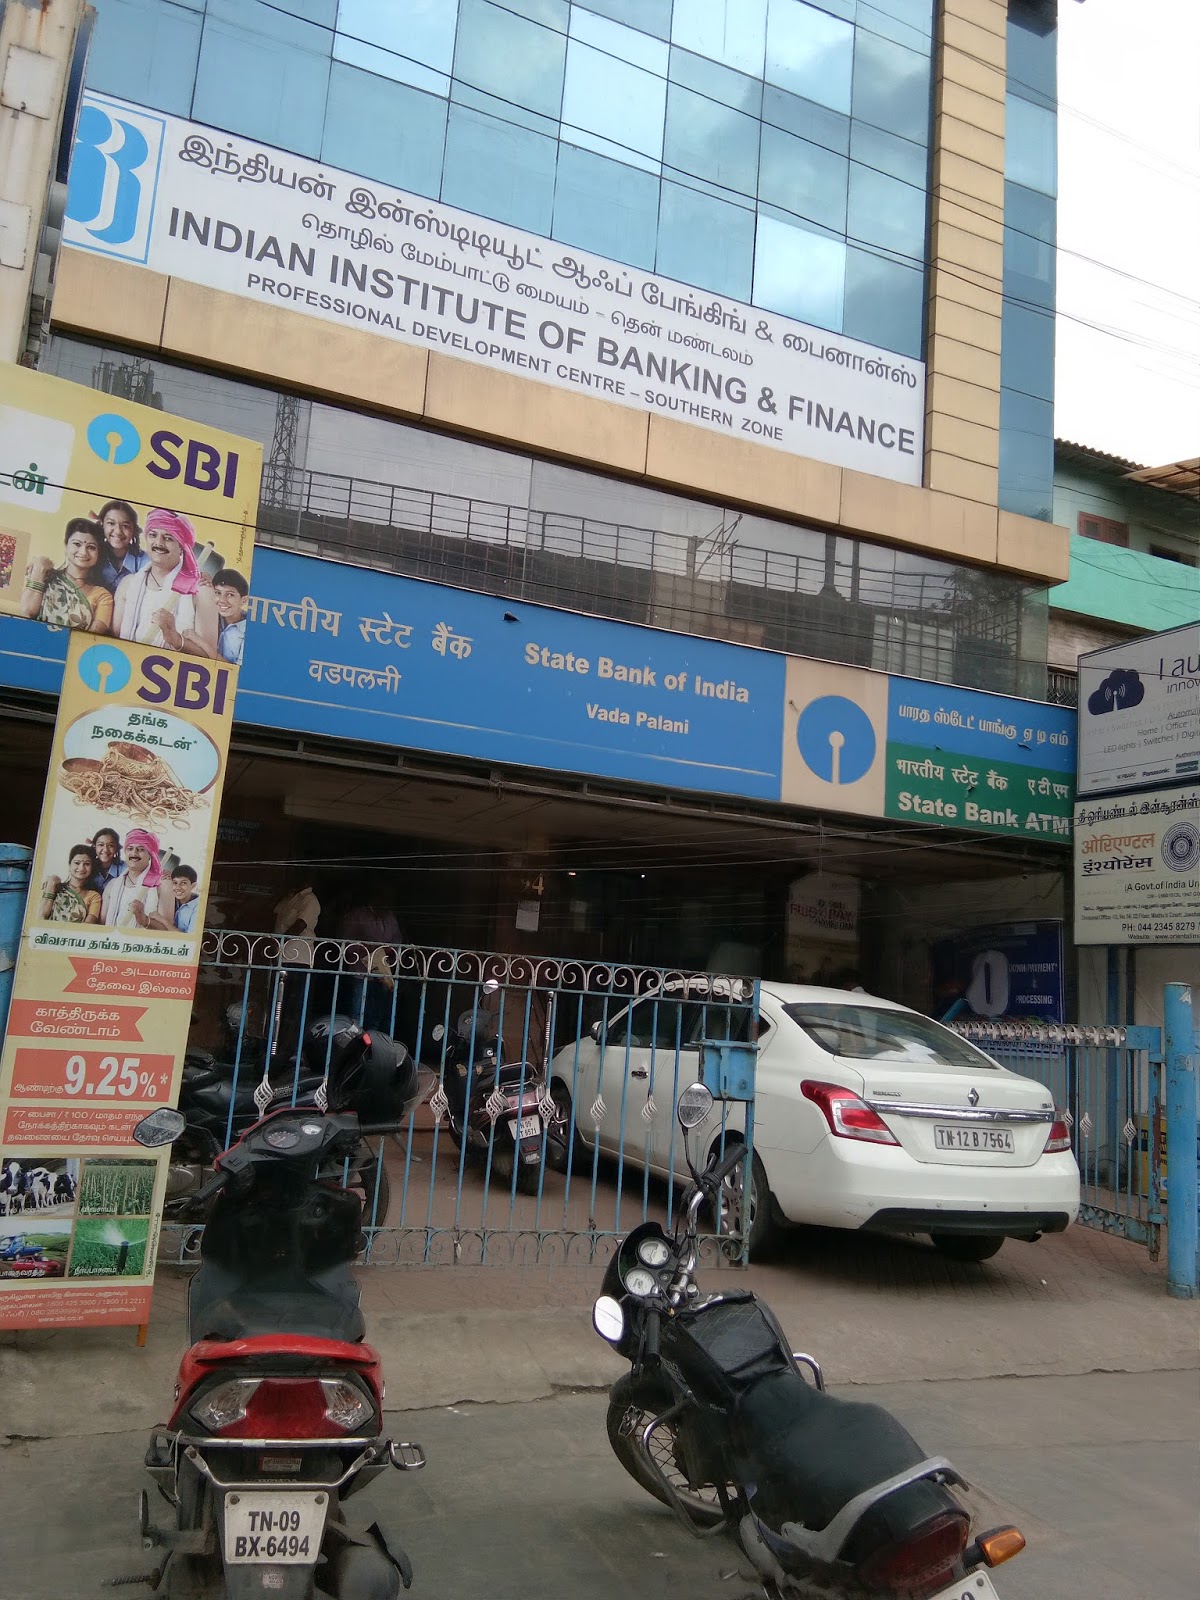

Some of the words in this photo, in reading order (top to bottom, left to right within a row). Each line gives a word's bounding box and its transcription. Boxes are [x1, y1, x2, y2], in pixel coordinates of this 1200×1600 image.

[178, 134, 337, 201] இந்தியன்
[552, 256, 632, 297] ஆஃப்
[641, 282, 746, 334] பேங்கிங்
[755, 320, 773, 342] &
[782, 332, 917, 389] பைனான்ஸ்
[302, 213, 394, 254] தொழில்
[401, 242, 510, 292] மேம்பாட்டு
[516, 283, 589, 315] மையம்
[611, 310, 662, 339] தென்
[668, 330, 754, 366] மண்டலம்
[168, 206, 315, 277] INDIAN
[330, 254, 526, 341] INSTITUTE
[538, 319, 585, 355] OF
[597, 336, 747, 405] BANKING
[757, 387, 777, 415] &
[788, 396, 915, 456] FINANCE
[246, 273, 406, 333] PROFESSIONAL
[412, 321, 551, 375] DEVELOPMENT
[556, 364, 625, 396] CENTRE
[644, 389, 733, 427] SOUTHERN
[741, 416, 784, 441] ZONE
[146, 430, 239, 499] SBI
[358, 611, 414, 649] स्टेट
[431, 621, 475, 659] बैंक
[308, 659, 402, 694] वडपलनी
[524, 642, 590, 674] State
[597, 656, 656, 687] Bank
[664, 671, 688, 692] of
[695, 674, 749, 703] India
[136, 655, 229, 716] SBI
[127, 711, 169, 729] தங்க
[586, 702, 630, 725] Vada
[636, 711, 689, 735] Palani
[898, 704, 930, 723] பாரத
[933, 707, 975, 729] ஸ்டேட்
[979, 718, 1016, 739] பாங்கு
[1049, 730, 1069, 746] எம்
[895, 758, 945, 781] भारतीय
[951, 764, 979, 786] स्टेट
[986, 769, 1009, 790] बैंक
[898, 791, 957, 818] State
[964, 801, 1019, 828] Bank
[1025, 811, 1070, 836] ATM
[1081, 833, 1156, 854] ओरिएण्टल
[1165, 880, 1186, 889] India
[1122, 923, 1136, 932] PH:
[1137, 923, 1152, 931] 044
[1154, 922, 1173, 931] 2345
[1175, 922, 1195, 931] 8279
[34, 933, 86, 948] விவசாய
[88, 937, 120, 952] தங்க
[122, 941, 190, 957] நகைக்கடன்
[91, 962, 118, 976] நில
[121, 966, 192, 979] அடமானம்
[86, 977, 135, 992] தேவை
[138, 981, 192, 995] இல்லை
[1016, 994, 1053, 1005] PROCESSING
[35, 1005, 120, 1022] காத்திருக்க
[30, 1020, 120, 1037] வேண்டாம்
[12, 1110, 26, 1118] 77
[28, 1110, 57, 1118] பைசா
[973, 1131, 979, 1147] B
[248, 1511, 300, 1532] TN-09
[234, 1535, 310, 1557] BX-6494
